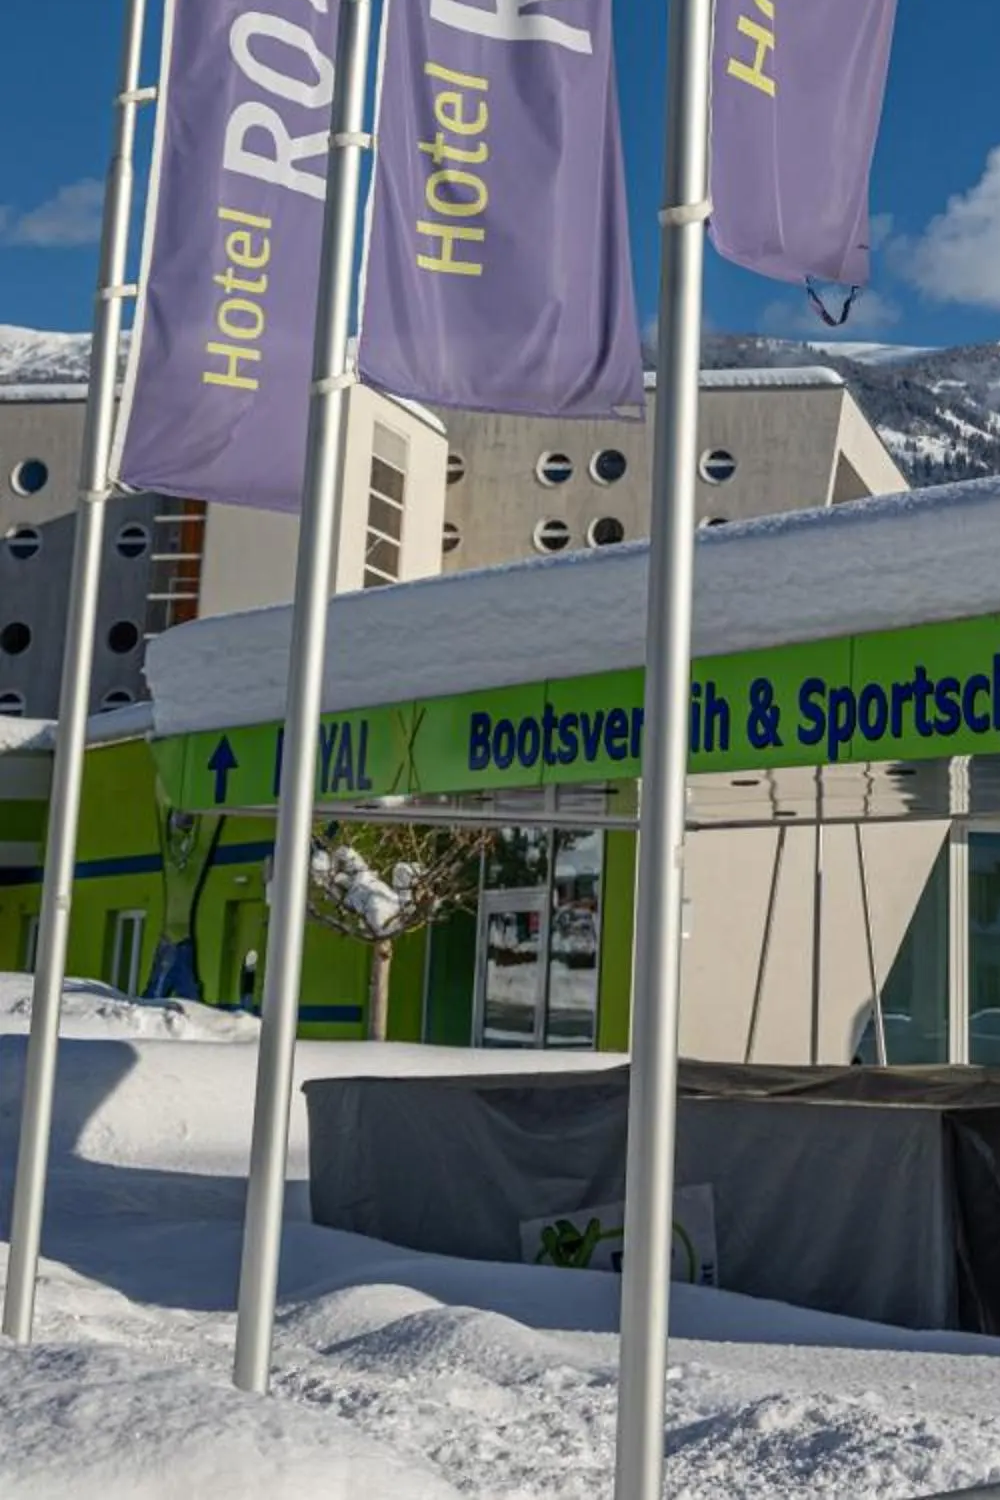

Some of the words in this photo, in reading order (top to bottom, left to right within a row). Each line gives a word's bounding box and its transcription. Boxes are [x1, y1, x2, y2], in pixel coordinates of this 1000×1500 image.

[416, 61, 489, 276] Hotel
[203, 207, 272, 391] Hotel
[273, 719, 372, 798] YAL
[468, 681, 731, 772] Bootsverih
[747, 677, 784, 750] &
